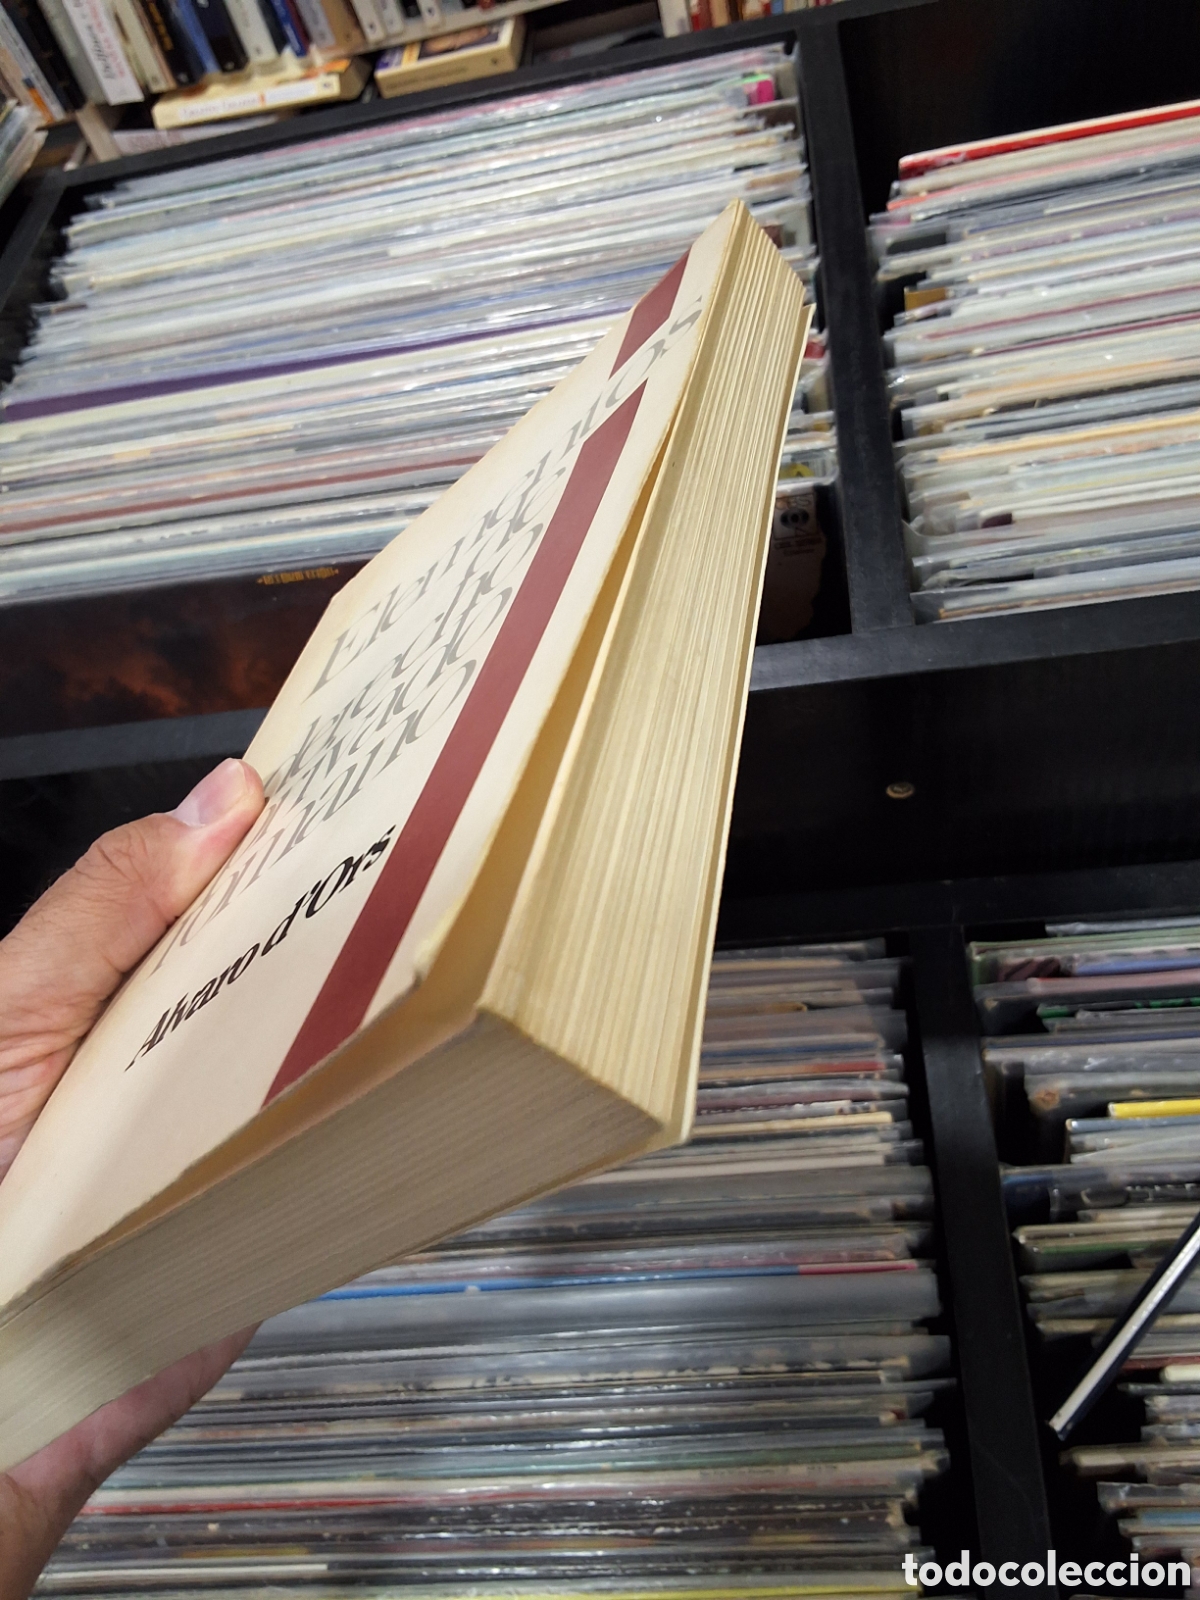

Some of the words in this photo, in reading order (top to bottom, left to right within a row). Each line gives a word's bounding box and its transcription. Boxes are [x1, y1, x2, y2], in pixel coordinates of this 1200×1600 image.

[301, 294, 703, 705] Elementos
[264, 522, 544, 796] derecho
[124, 942, 260, 1072] Alvaro
[261, 824, 396, 957] d'Ors
[146, 659, 477, 980] romano
